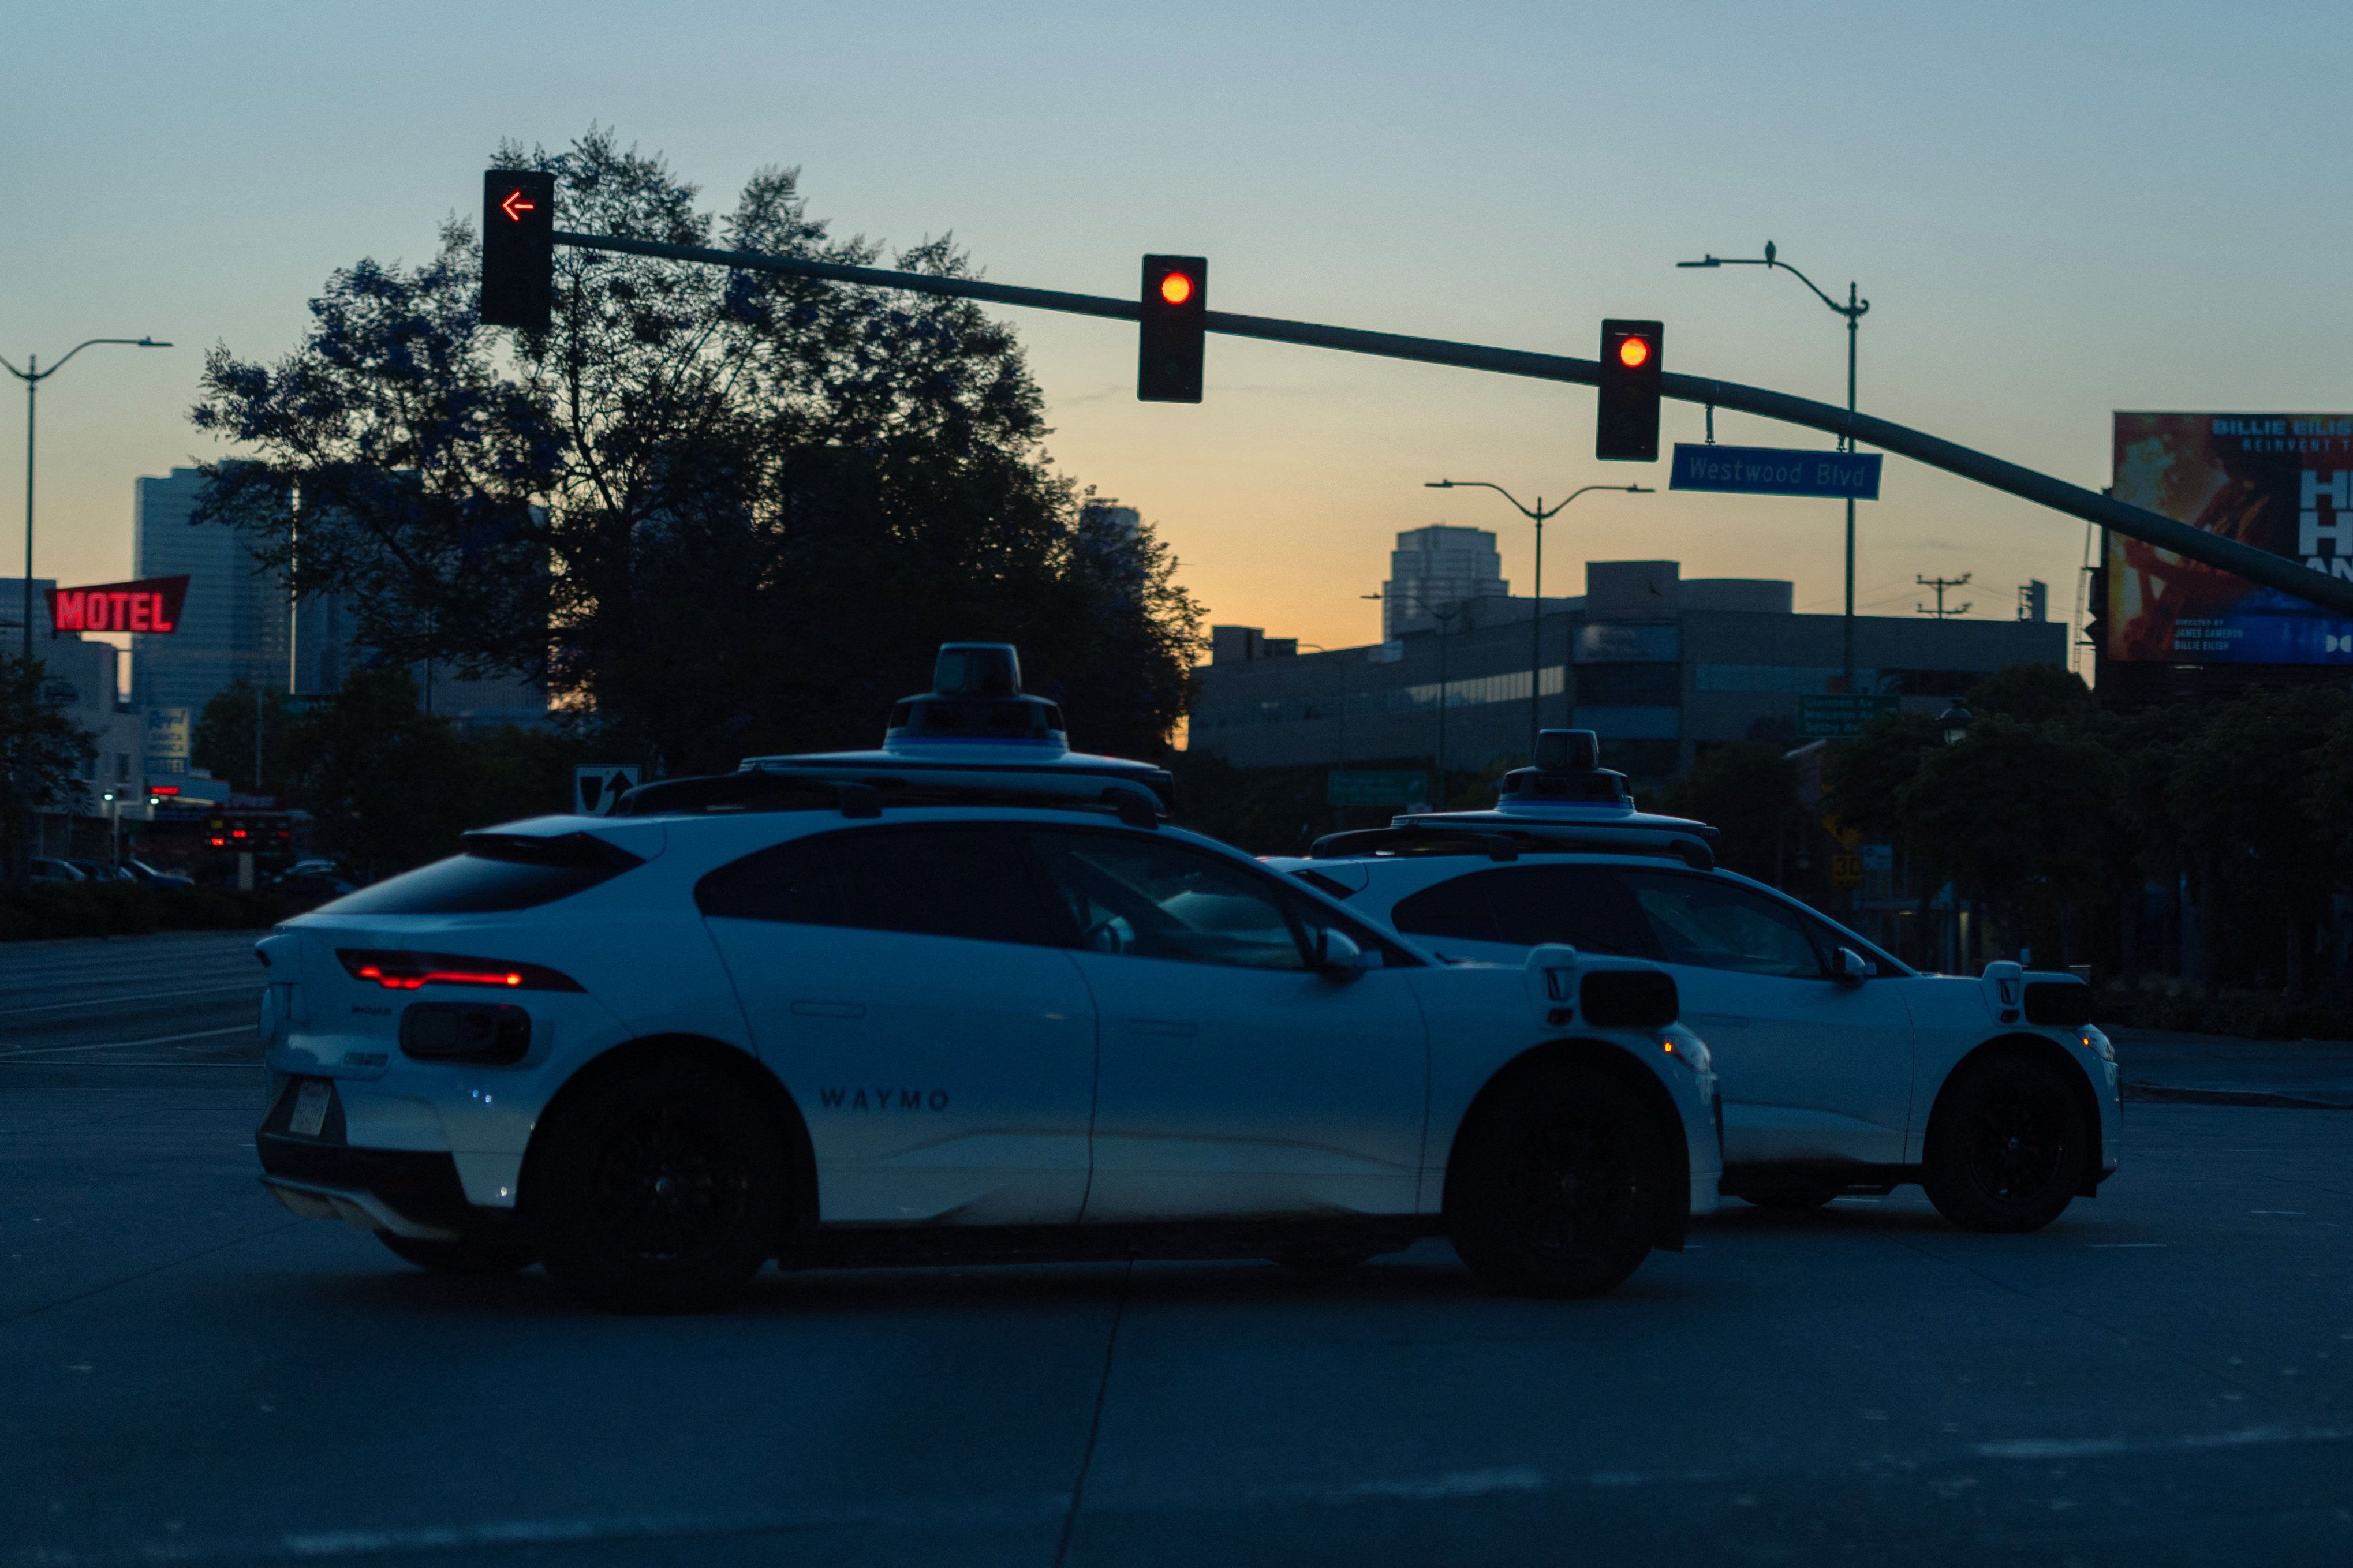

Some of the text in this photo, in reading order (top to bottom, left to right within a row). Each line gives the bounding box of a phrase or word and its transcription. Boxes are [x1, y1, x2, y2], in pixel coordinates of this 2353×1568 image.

[2213, 420, 2286, 436] BILLIE
[2242, 438, 2330, 452] REINVENT
[1690, 457, 1865, 487] Westwood Blvd
[2300, 470, 2353, 510] H
[56, 590, 173, 631] MOTEL
[2175, 628, 2243, 639] JAMES CAMERON
[2175, 641, 2229, 650] BILLIE EILISH
[1836, 858, 1862, 876] 30
[819, 1087, 949, 1111] WAYMO
